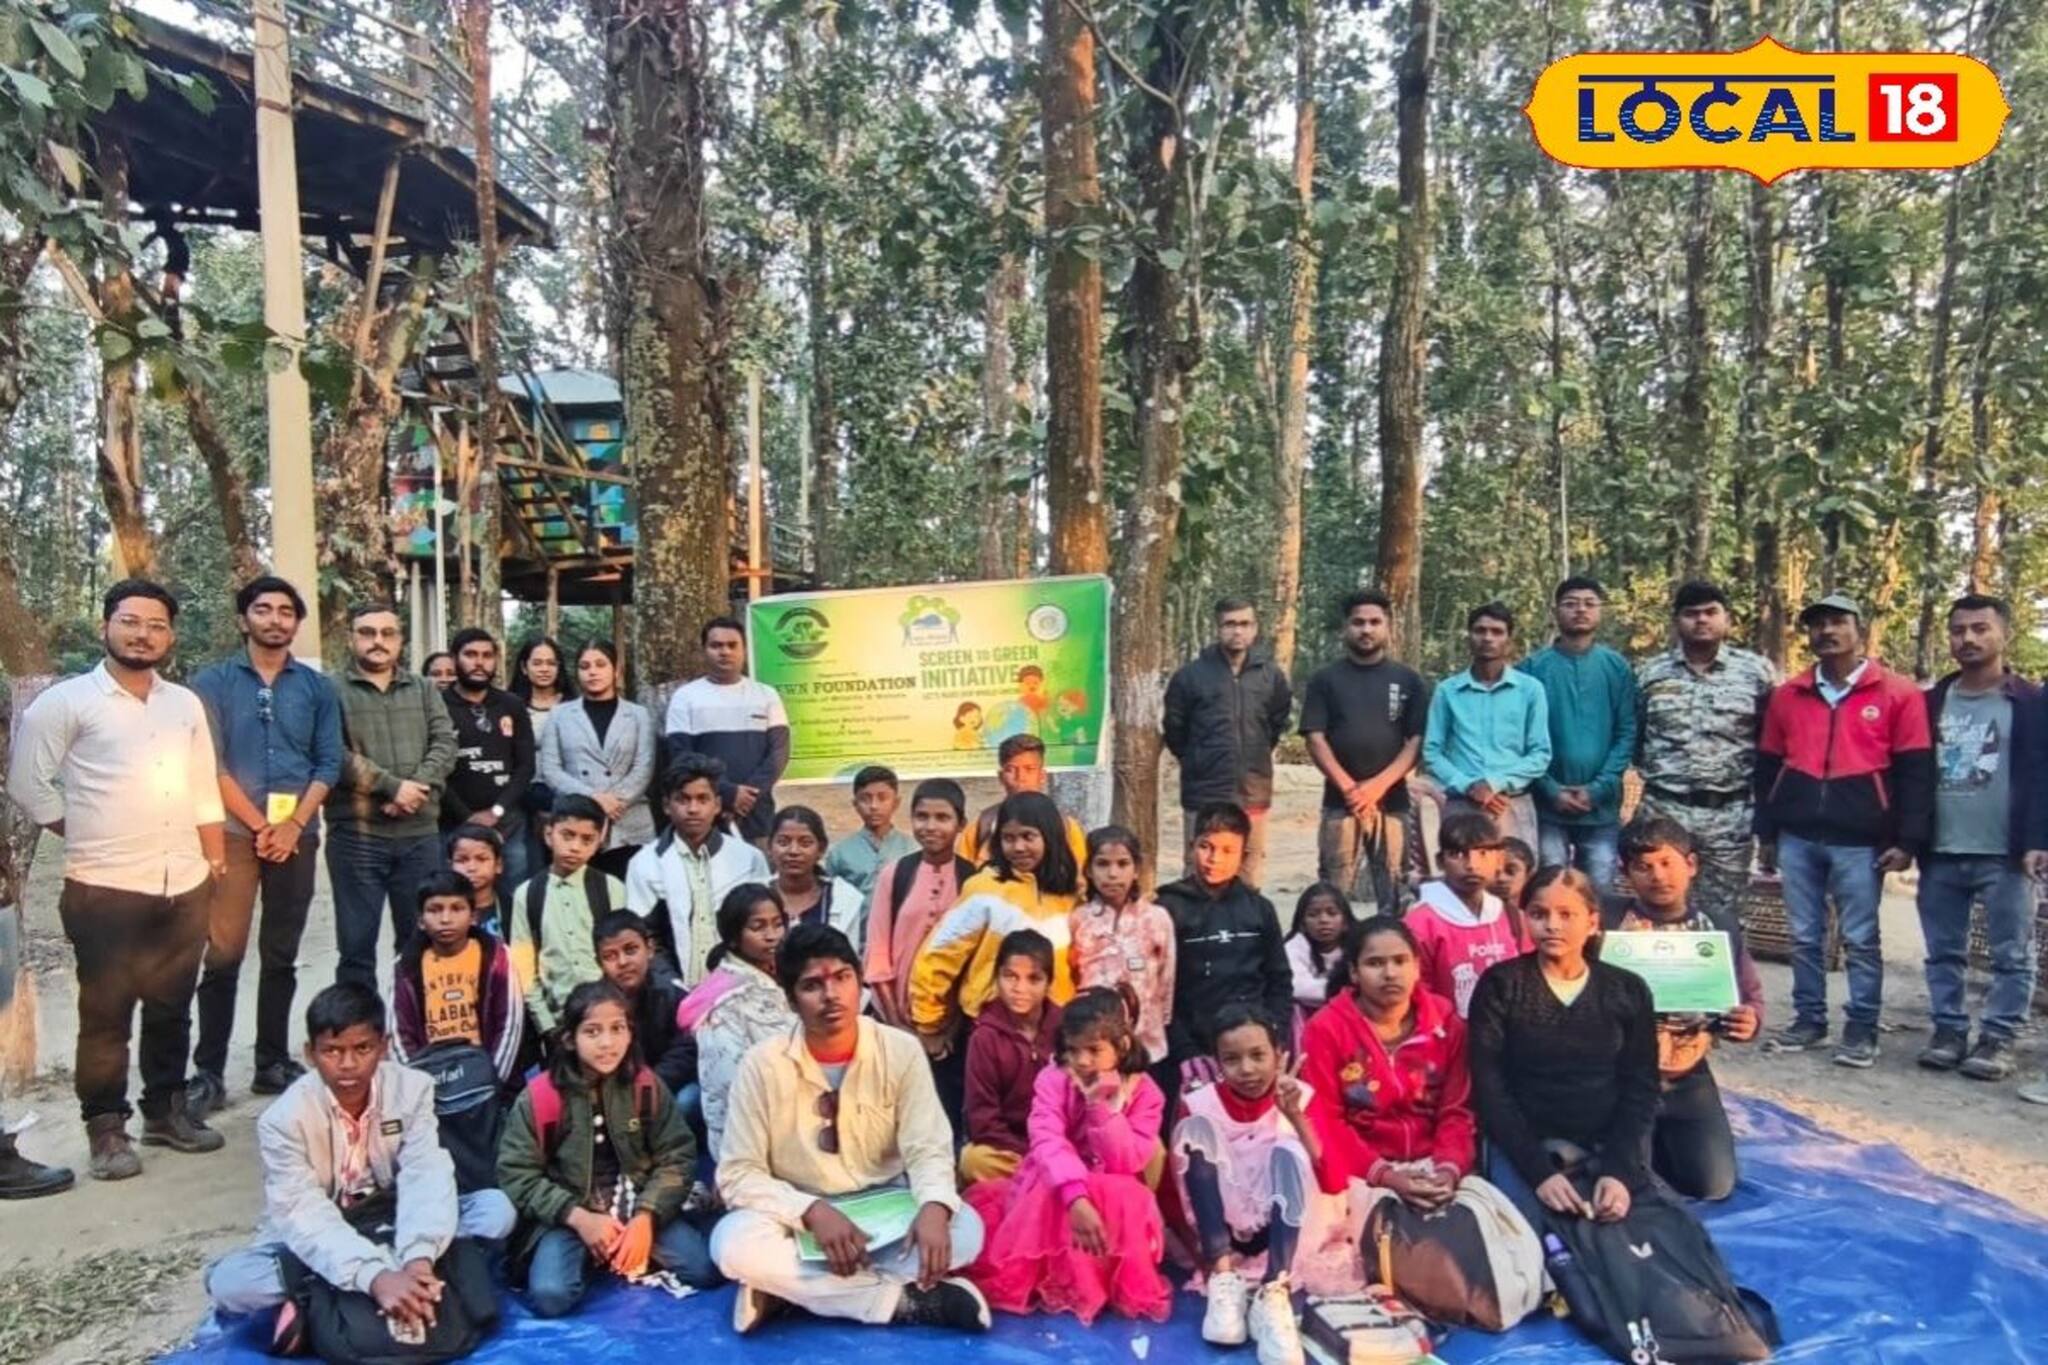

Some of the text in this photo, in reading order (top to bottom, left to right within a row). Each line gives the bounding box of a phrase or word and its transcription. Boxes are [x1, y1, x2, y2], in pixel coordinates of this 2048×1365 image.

[919, 648, 973, 667] SCREEN
[993, 644, 1039, 662] GREEN
[813, 676, 917, 694] FOUNDATION
[921, 664, 1019, 689] INITIATIVE
